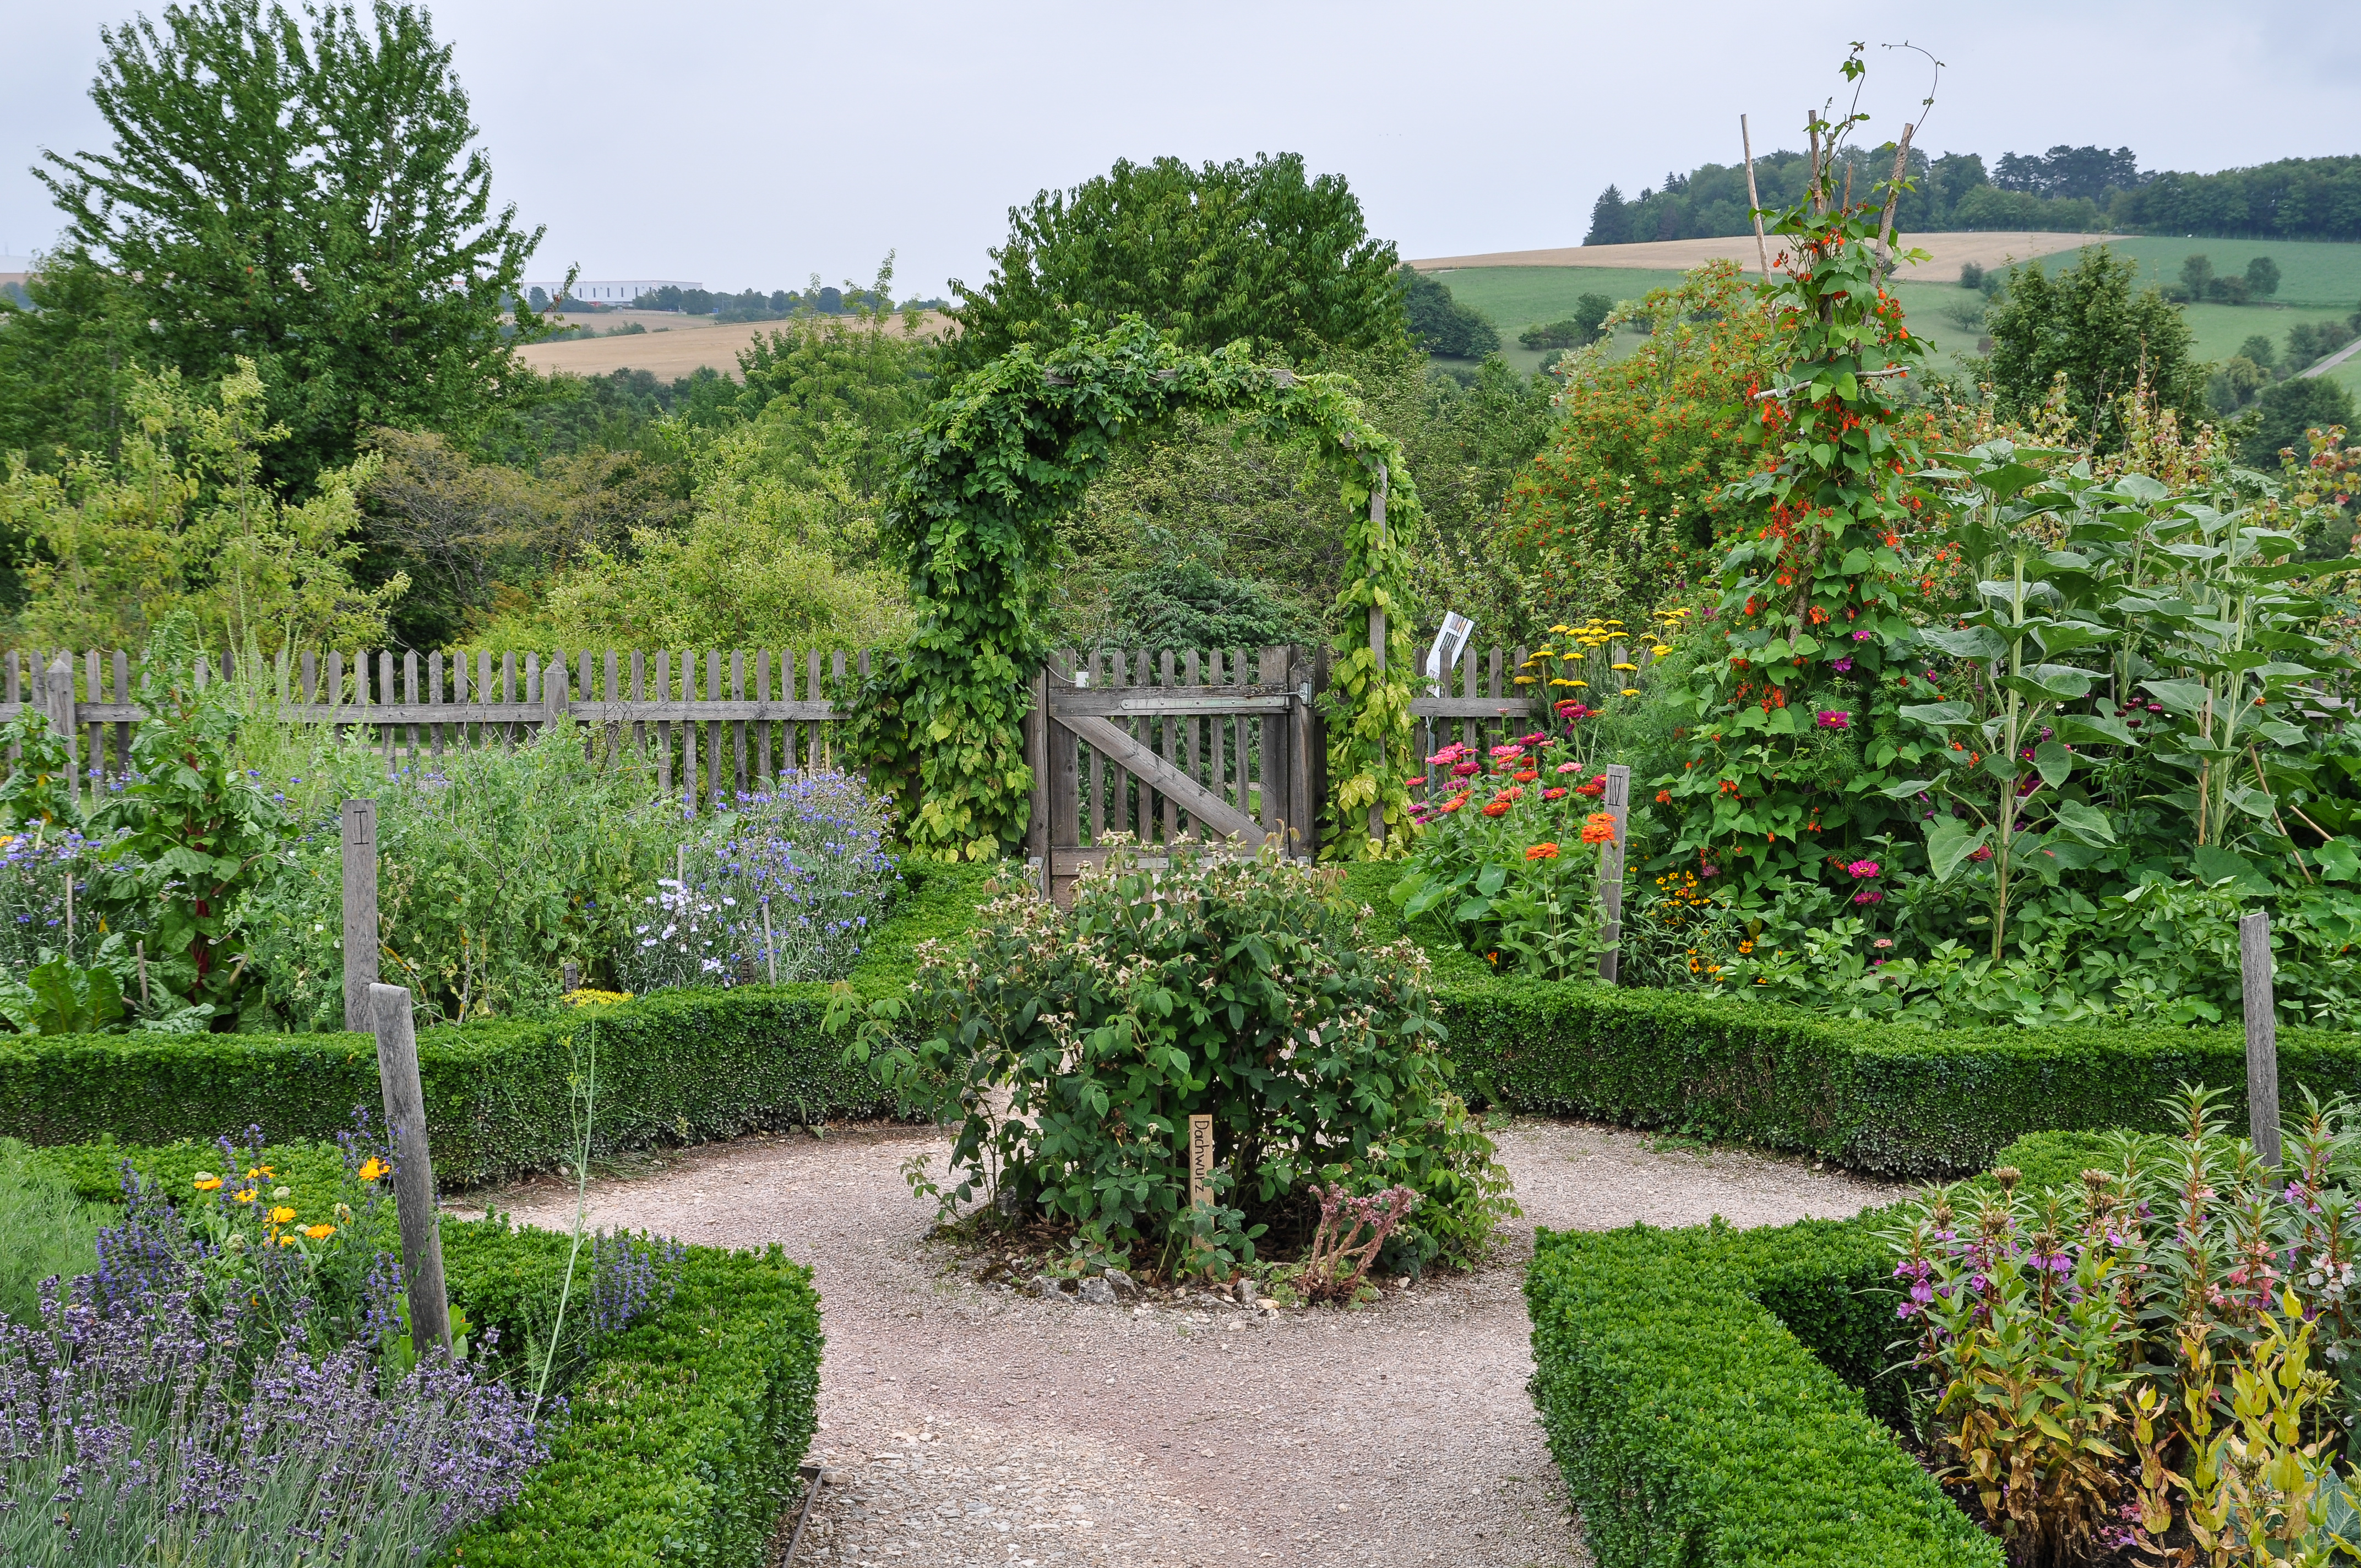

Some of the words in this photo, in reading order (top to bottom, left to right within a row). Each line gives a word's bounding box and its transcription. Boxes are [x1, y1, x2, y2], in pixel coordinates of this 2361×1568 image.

[1608, 775, 1623, 807] IV
[353, 810, 369, 845] I
[566, 969, 576, 990] Erb
[1194, 1120, 1210, 1194] Dachwurz
